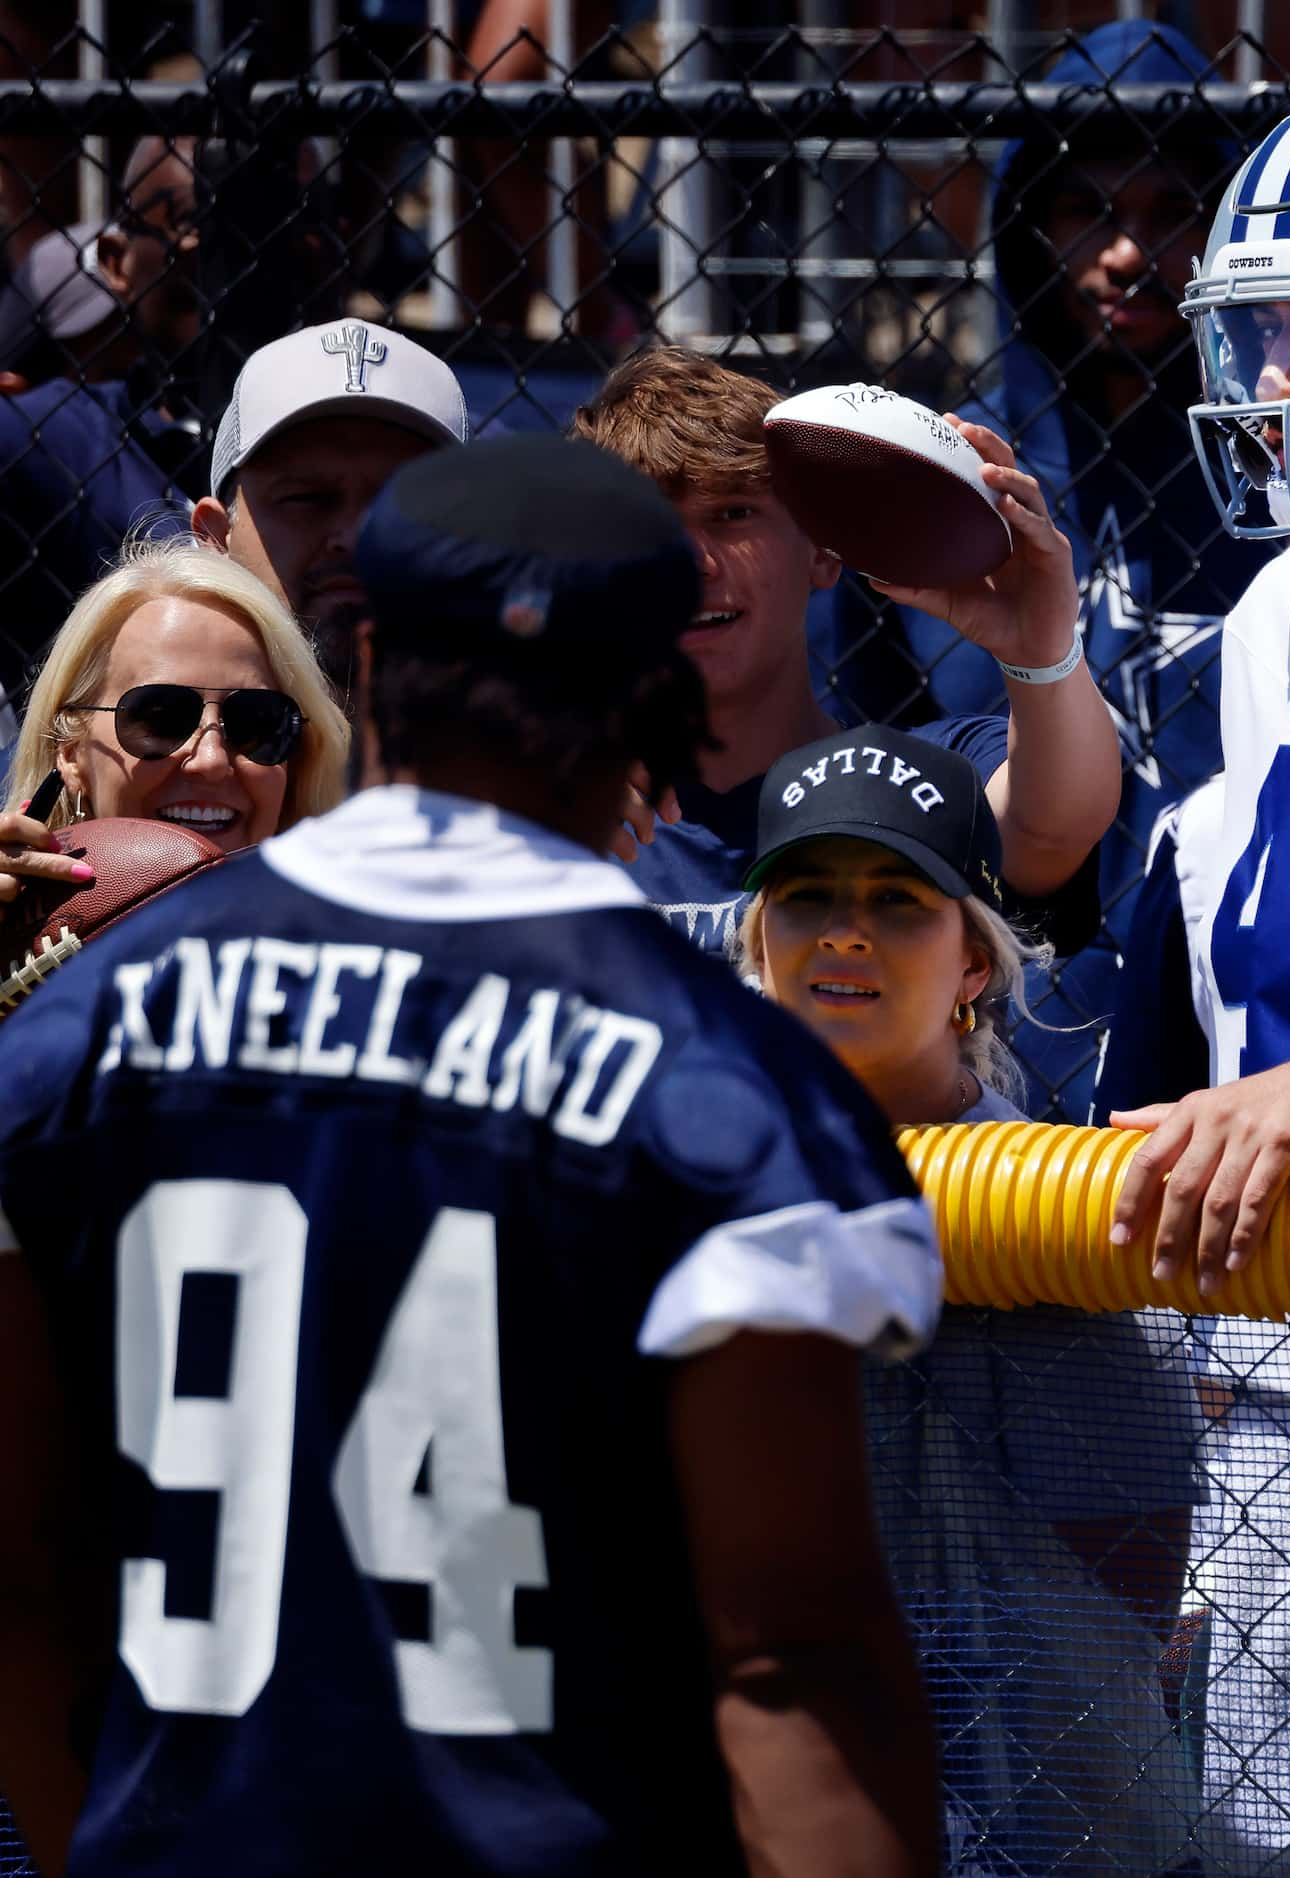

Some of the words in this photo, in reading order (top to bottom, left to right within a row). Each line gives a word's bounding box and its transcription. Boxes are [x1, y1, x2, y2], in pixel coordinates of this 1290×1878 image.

[1228, 256, 1274, 269] COWBOYS
[781, 746, 945, 813] DALLAS
[99, 936, 664, 1147] KNEELAND
[116, 1178, 554, 1736] 94
